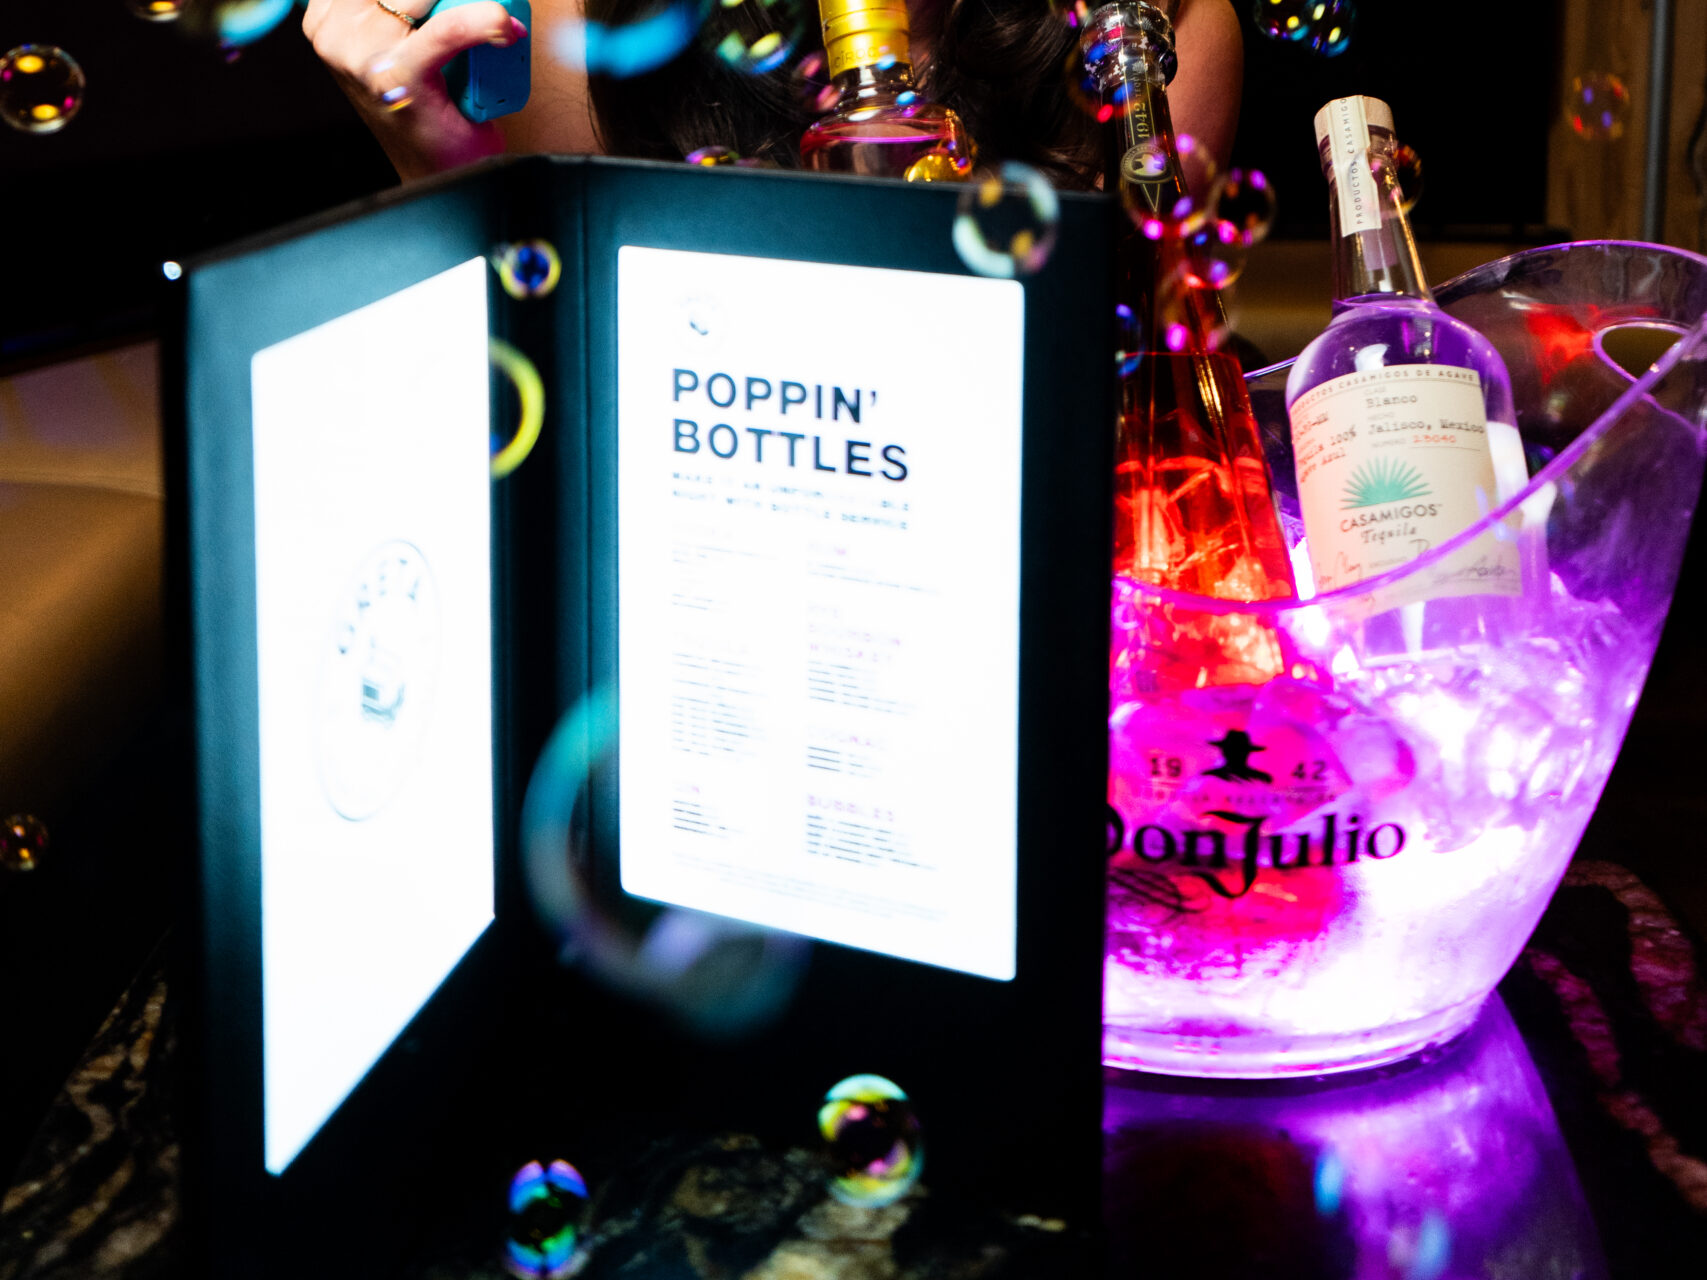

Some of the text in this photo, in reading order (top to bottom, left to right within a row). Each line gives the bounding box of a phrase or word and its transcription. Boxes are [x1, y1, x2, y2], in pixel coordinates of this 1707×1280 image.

[1134, 101, 1151, 138] 1942
[1350, 158, 1364, 225] PRODUCTOS
[1337, 369, 1410, 391] CASAMIGOS
[1415, 369, 1432, 378] DE
[1437, 370, 1475, 382] AGAVE
[671, 368, 878, 424] POPPIN'
[1365, 392, 1418, 408] Blanco
[671, 418, 909, 483] BOTTLES
[1360, 522, 1418, 545] Tequila
[1148, 755, 1328, 781] 19 42
